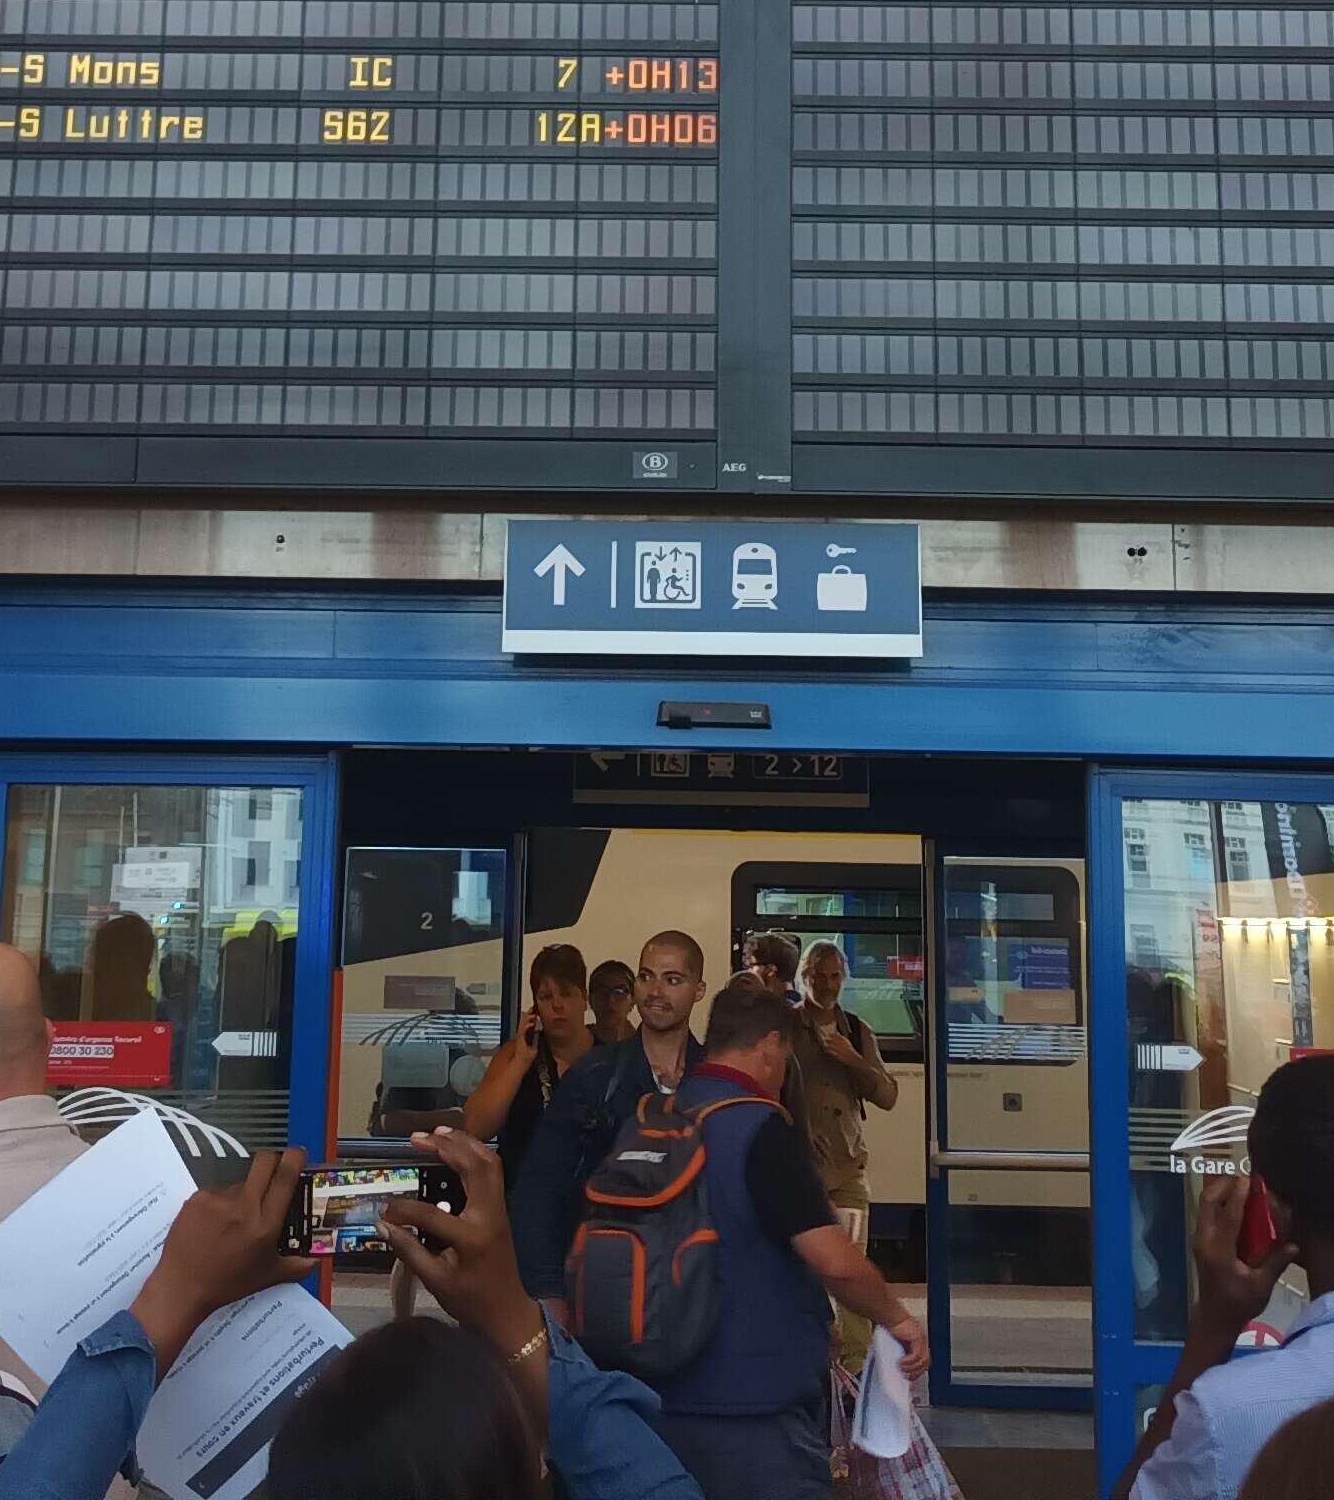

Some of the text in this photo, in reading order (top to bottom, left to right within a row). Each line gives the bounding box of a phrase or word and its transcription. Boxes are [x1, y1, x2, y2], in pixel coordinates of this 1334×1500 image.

[70, 54, 160, 86] Mons
[350, 56, 393, 88] IC
[557, 58, 578, 90] 7
[65, 107, 203, 140] Luttre
[323, 111, 390, 142] S62
[722, 463, 747, 472] AEG
[420, 912, 434, 930] 2
[78, 1046, 92, 1056] 30
[94, 1046, 114, 1056] 230
[1170, 1154, 1235, 1175] la Gare
